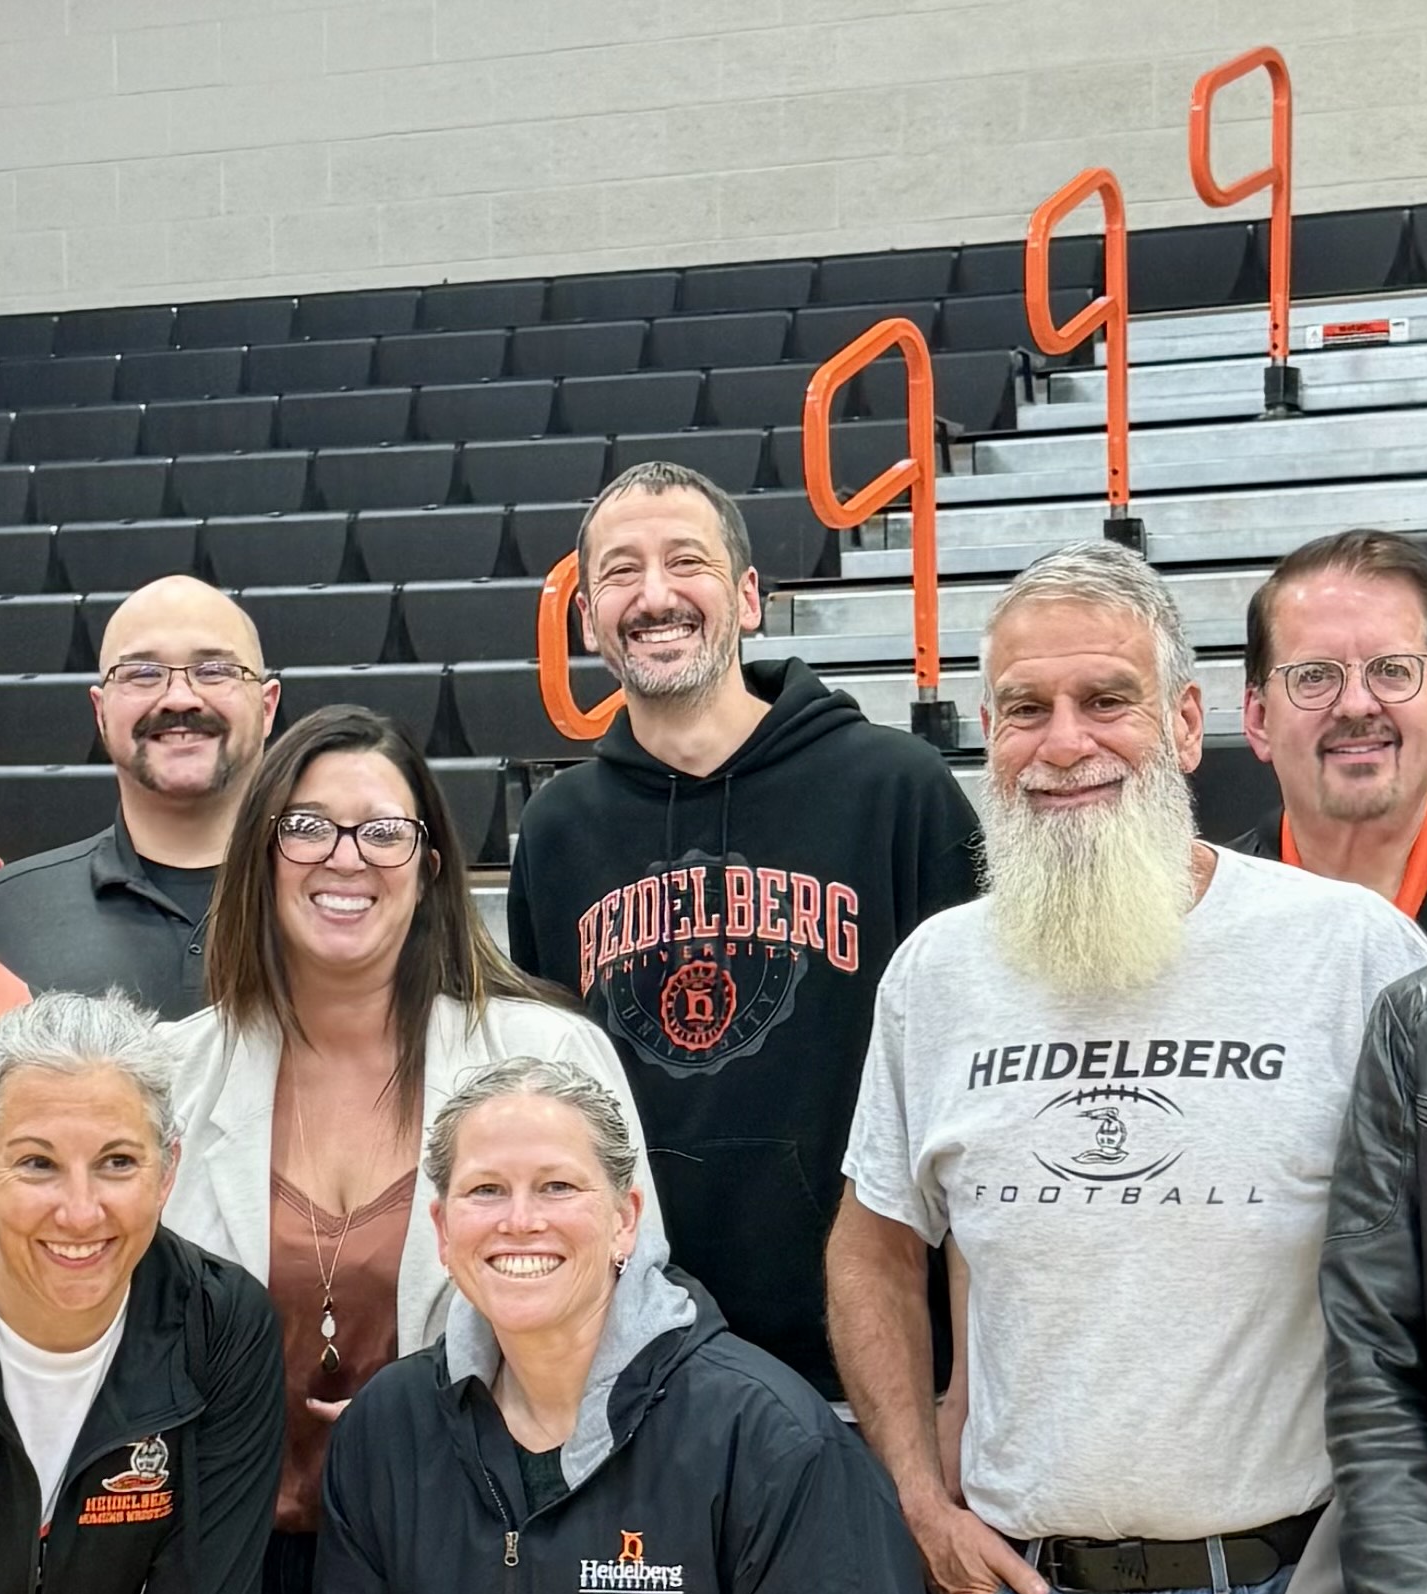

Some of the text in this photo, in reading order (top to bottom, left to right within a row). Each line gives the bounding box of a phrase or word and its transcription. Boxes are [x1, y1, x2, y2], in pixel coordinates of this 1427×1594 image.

[578, 866, 859, 999] HEIDELBERG
[604, 942, 801, 980] UNIVERSITY
[968, 1040, 1286, 1090] HEIDELBERG
[976, 1186, 1264, 1205] FOOTBALL
[580, 1557, 683, 1588] Heidelberg
